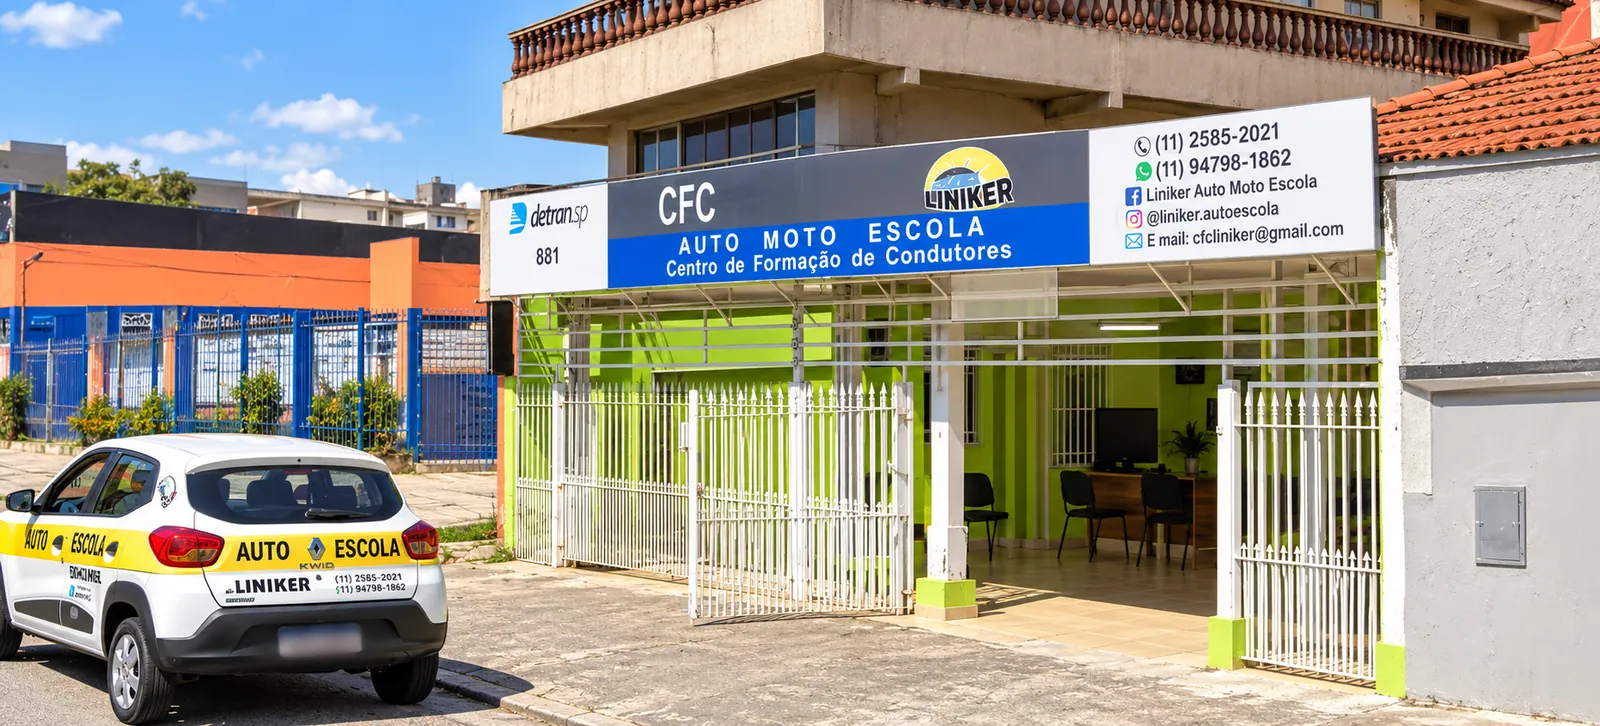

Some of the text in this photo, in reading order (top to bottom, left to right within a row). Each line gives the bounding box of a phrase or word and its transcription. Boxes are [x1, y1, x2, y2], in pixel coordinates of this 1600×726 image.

[1155, 122, 1280, 156] (11) 2585-2021
[1156, 148, 1292, 182] (11) 94798-1862
[924, 177, 1014, 211] LINIKER
[1146, 174, 1318, 202] Liniker Auto Moto Escola
[530, 203, 589, 229] detran.sp
[658, 181, 716, 226] CFC
[1146, 201, 1280, 227] @liniker.autoescola
[678, 215, 985, 255] AUTO MOTO ESCOLA
[1192, 222, 1345, 245] cfcliniker@gmail.com
[536, 246, 559, 266] 881
[666, 243, 1012, 277] Centro de Formação de Condutores
[24, 528, 107, 557] AUTO ESCOLA
[236, 537, 401, 562] AUTO ESCOLA
[299, 562, 335, 570] KWID
[334, 572, 402, 585] (11) 2585-2021
[235, 577, 311, 594] LINIKER
[355, 582, 406, 593] 94798-1862
